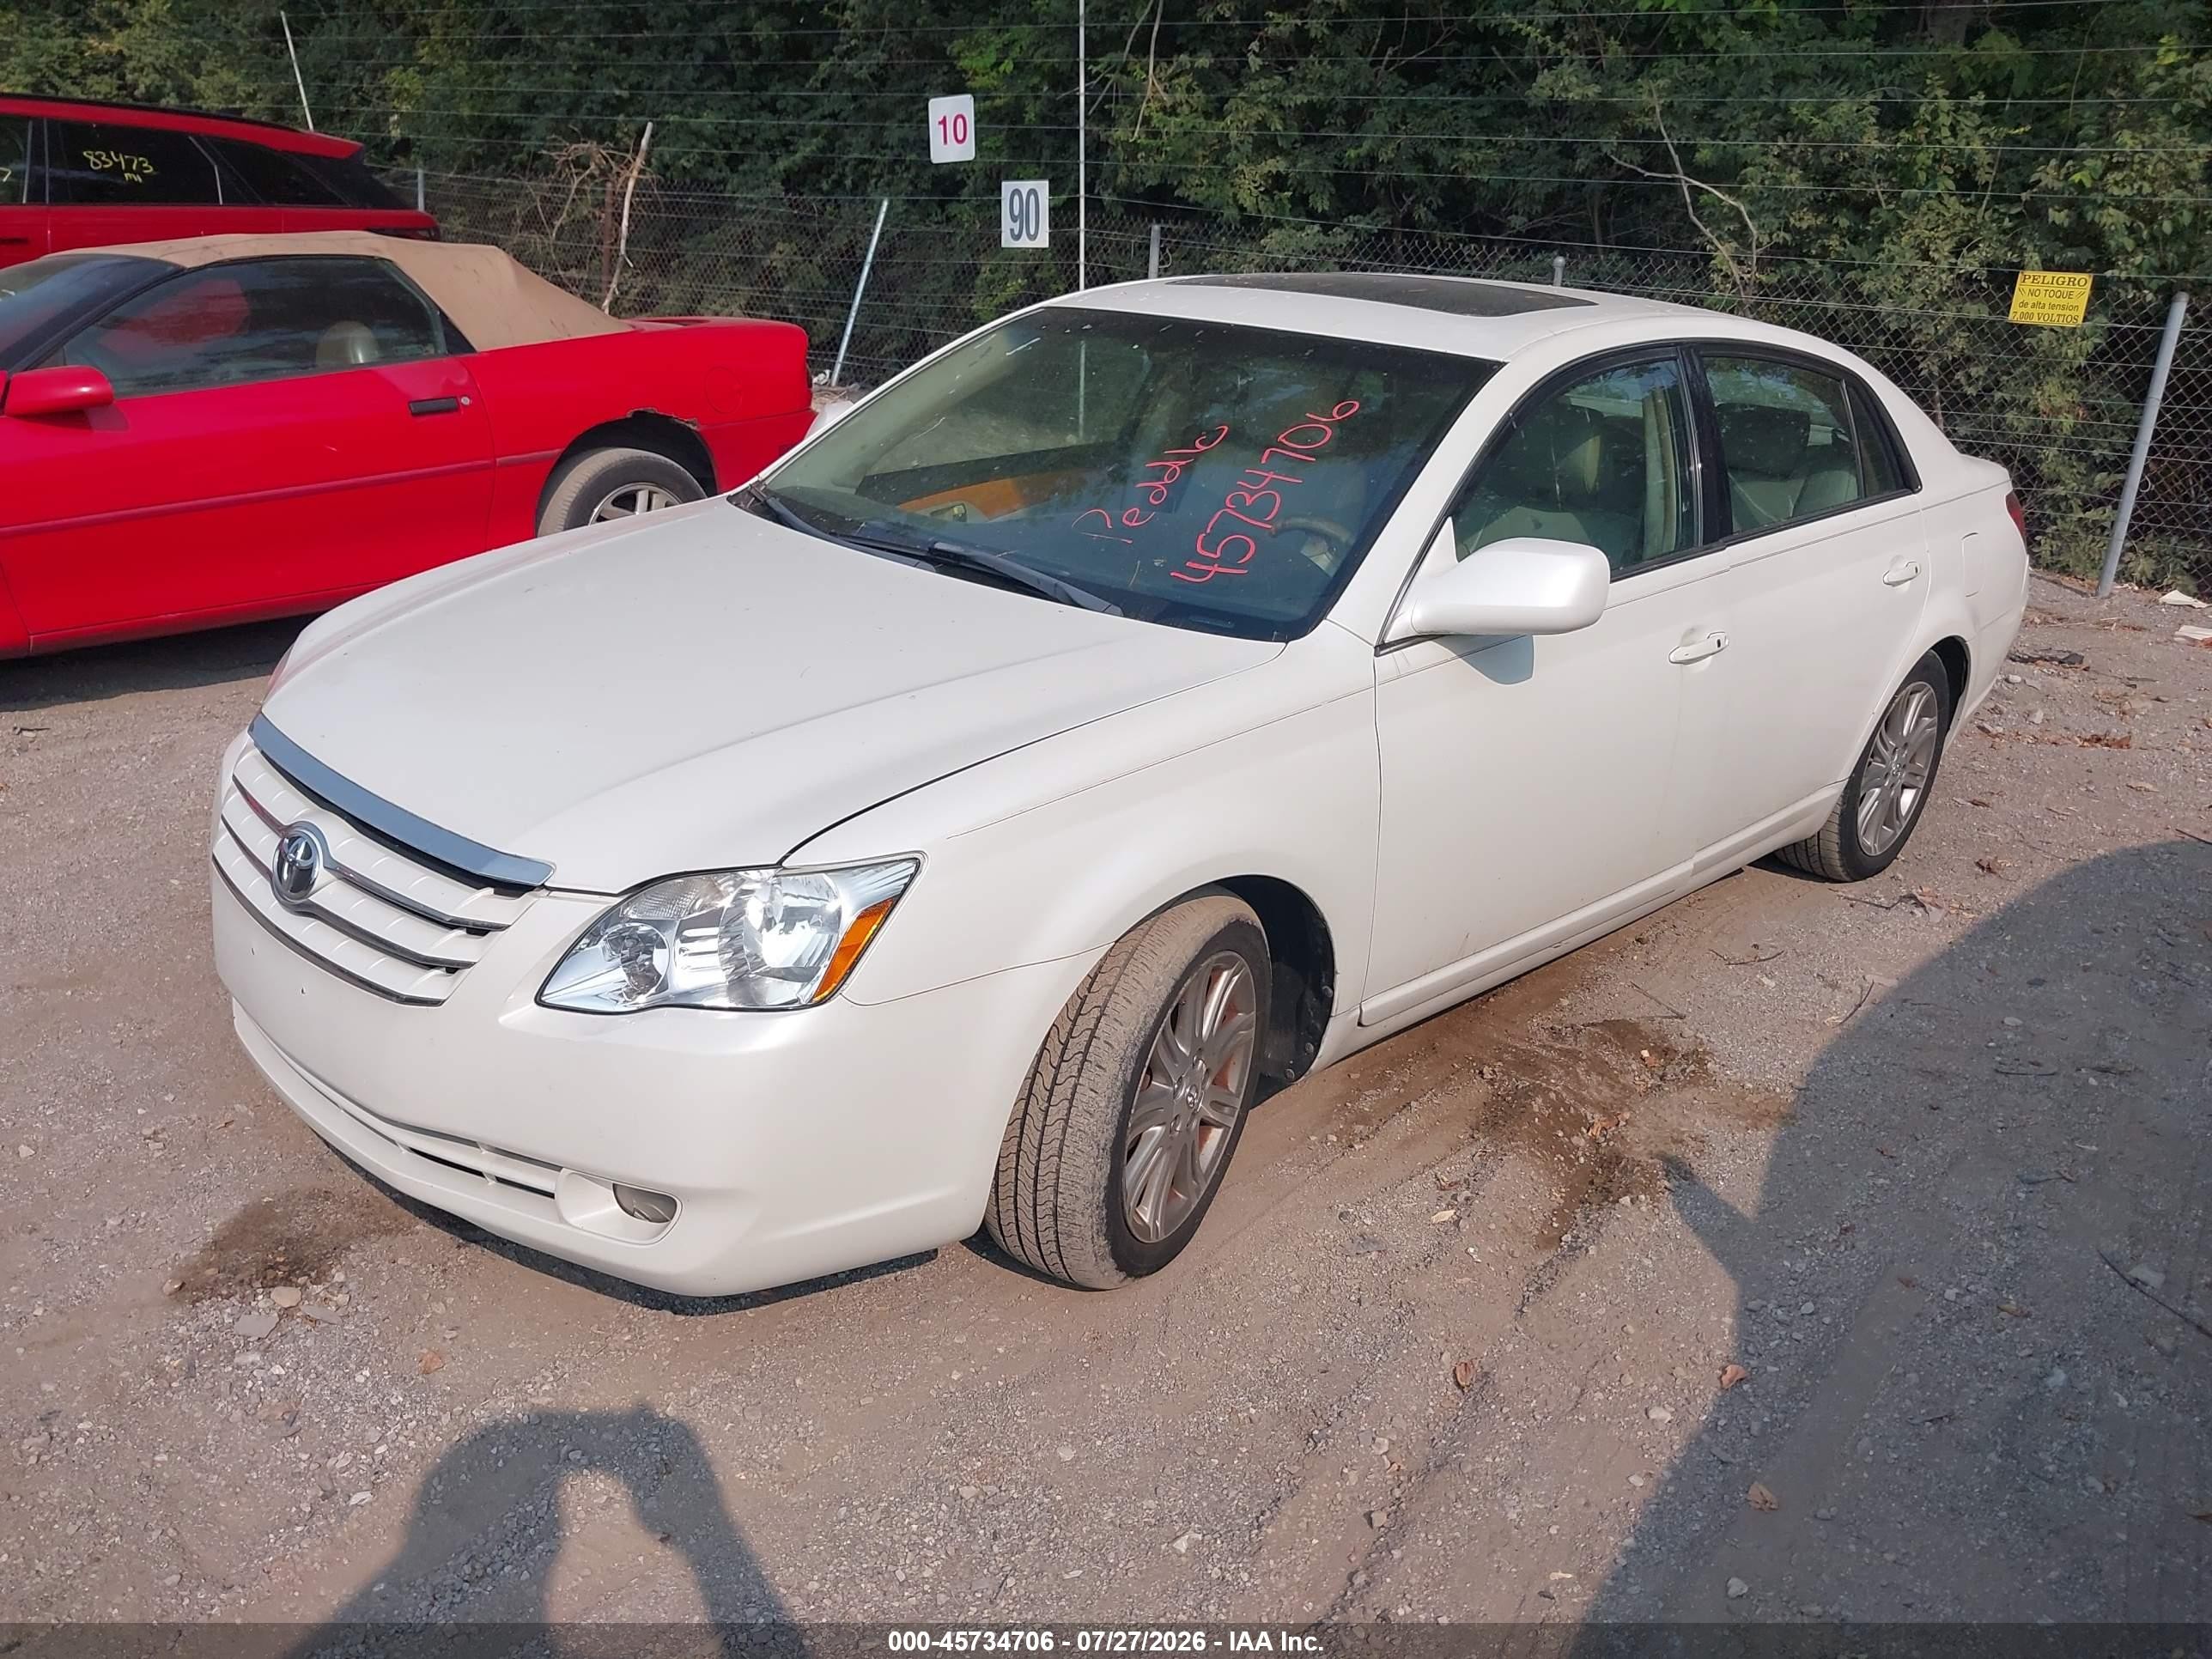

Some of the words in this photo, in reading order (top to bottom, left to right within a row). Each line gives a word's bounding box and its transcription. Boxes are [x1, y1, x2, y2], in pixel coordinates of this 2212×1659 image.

[938, 113, 968, 145] 10
[82, 150, 154, 173] 83473
[1008, 187, 1041, 242] 90
[2022, 274, 2088, 288] PELIGRO
[2027, 289, 2041, 298] NO
[2044, 289, 2075, 300] TOQUE
[2018, 300, 2028, 308] de
[2031, 301, 2045, 310] alta
[2048, 301, 2079, 312] tension
[2012, 311, 2034, 321] 7,000
[2037, 313, 2079, 324] VOLTIOS
[1170, 400, 1360, 583] 45734706
